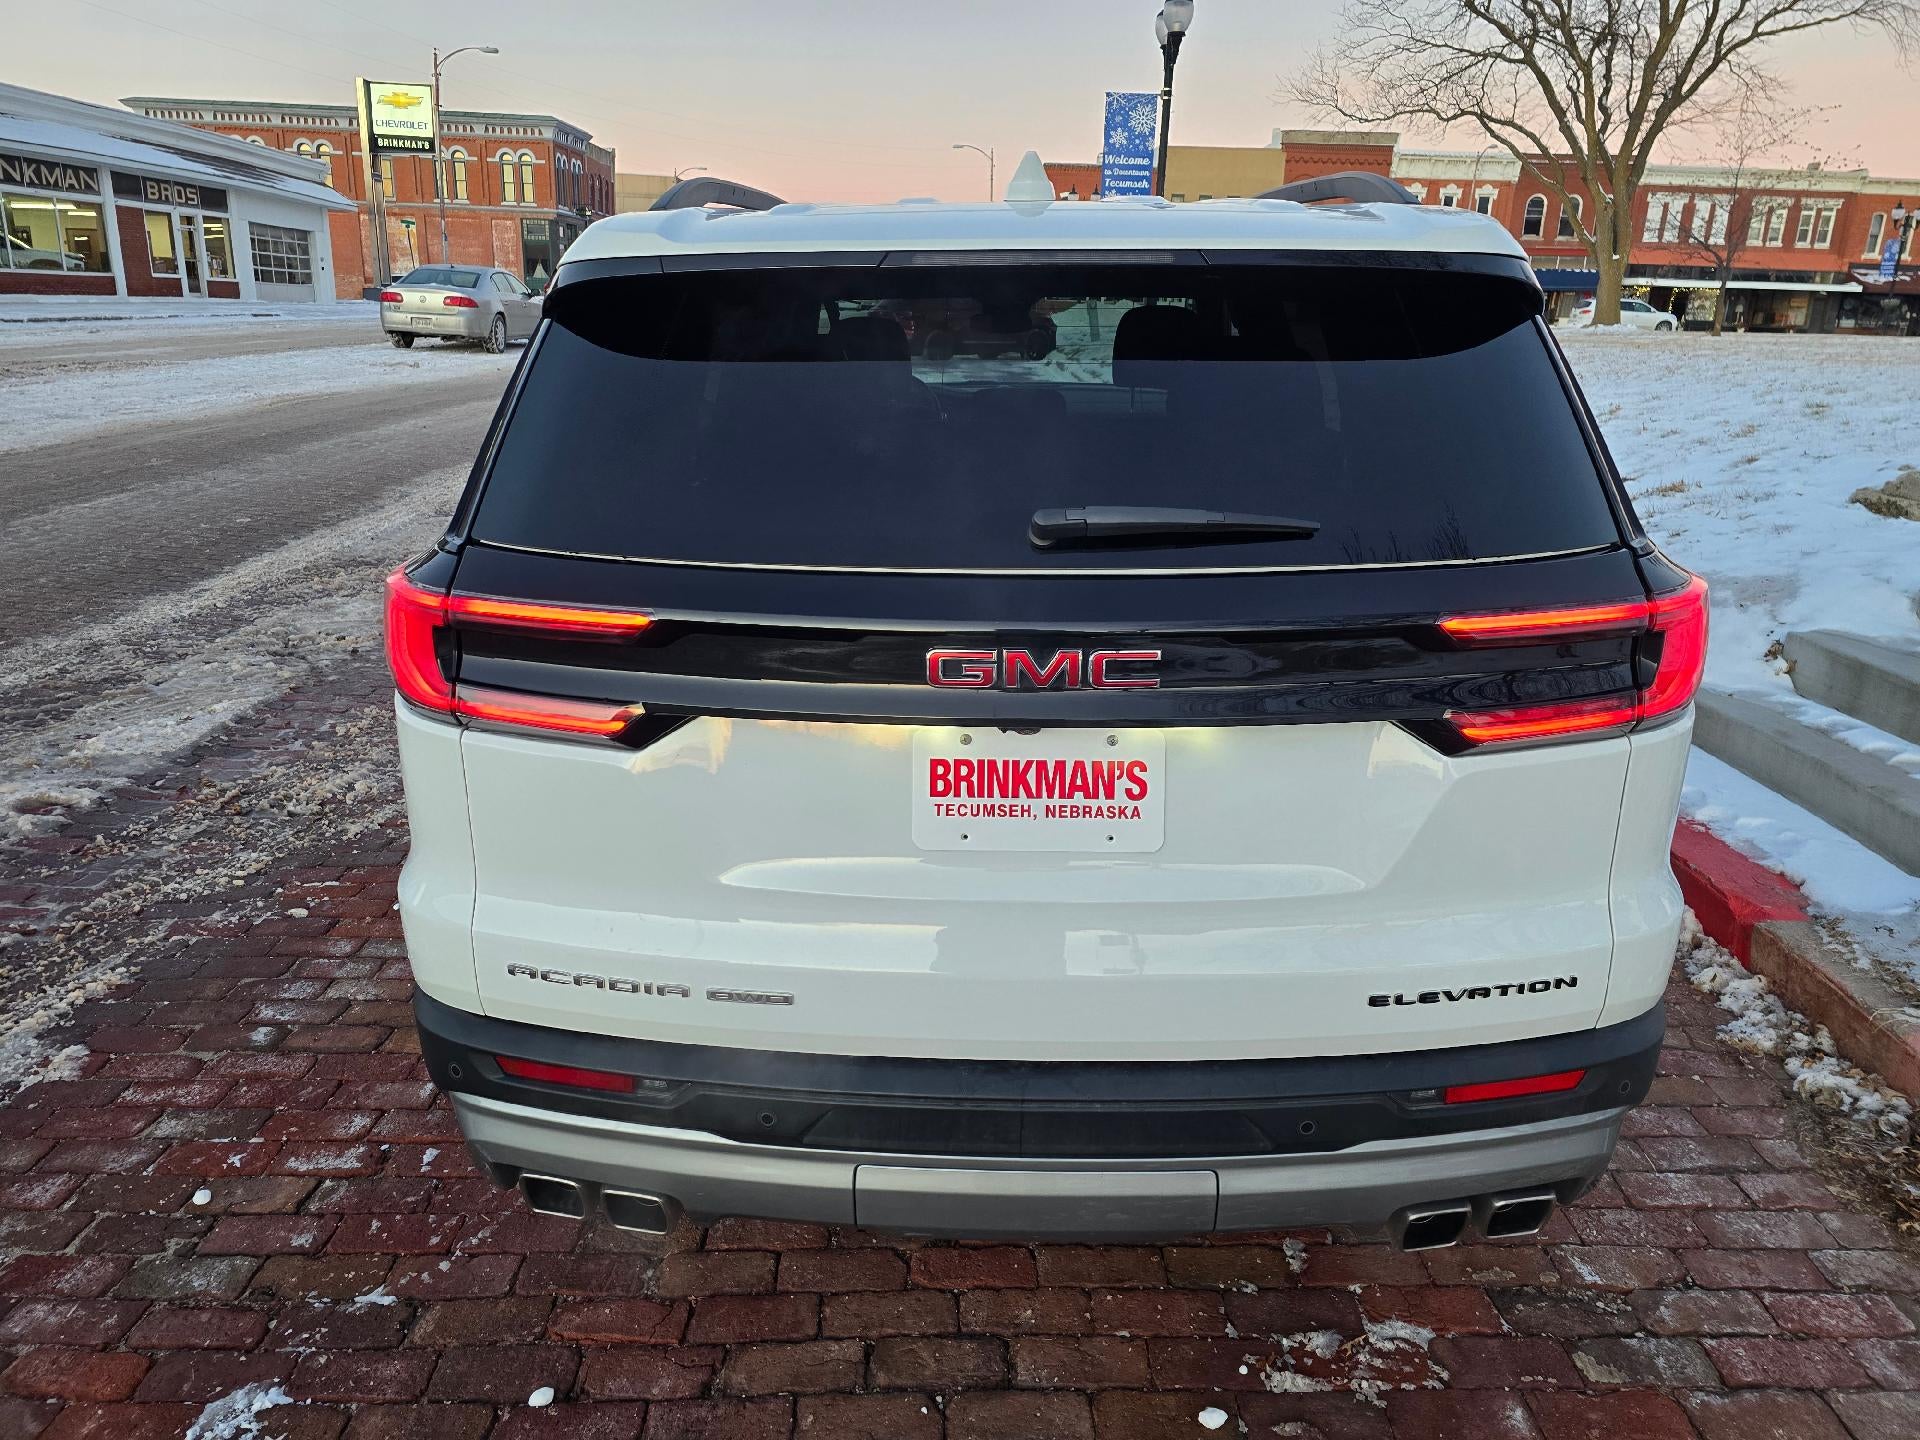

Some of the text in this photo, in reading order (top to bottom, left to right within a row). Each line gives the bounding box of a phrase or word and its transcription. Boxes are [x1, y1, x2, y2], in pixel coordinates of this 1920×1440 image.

[375, 120, 428, 130] CHEVROLET
[377, 137, 430, 149] BRINKMAN'S
[1104, 154, 1151, 165] Welcome
[1112, 167, 1150, 176] Downtown
[1104, 178, 1150, 188] Tecumseh
[146, 181, 198, 205] BROS
[926, 648, 1162, 689] GMC
[929, 758, 1148, 801] BRINKMAN'S
[934, 803, 1142, 820] TECUMSEH, NEBRASKA
[506, 962, 795, 1006] ACADIA AWD
[1367, 975, 1578, 1008] ELEVATION
